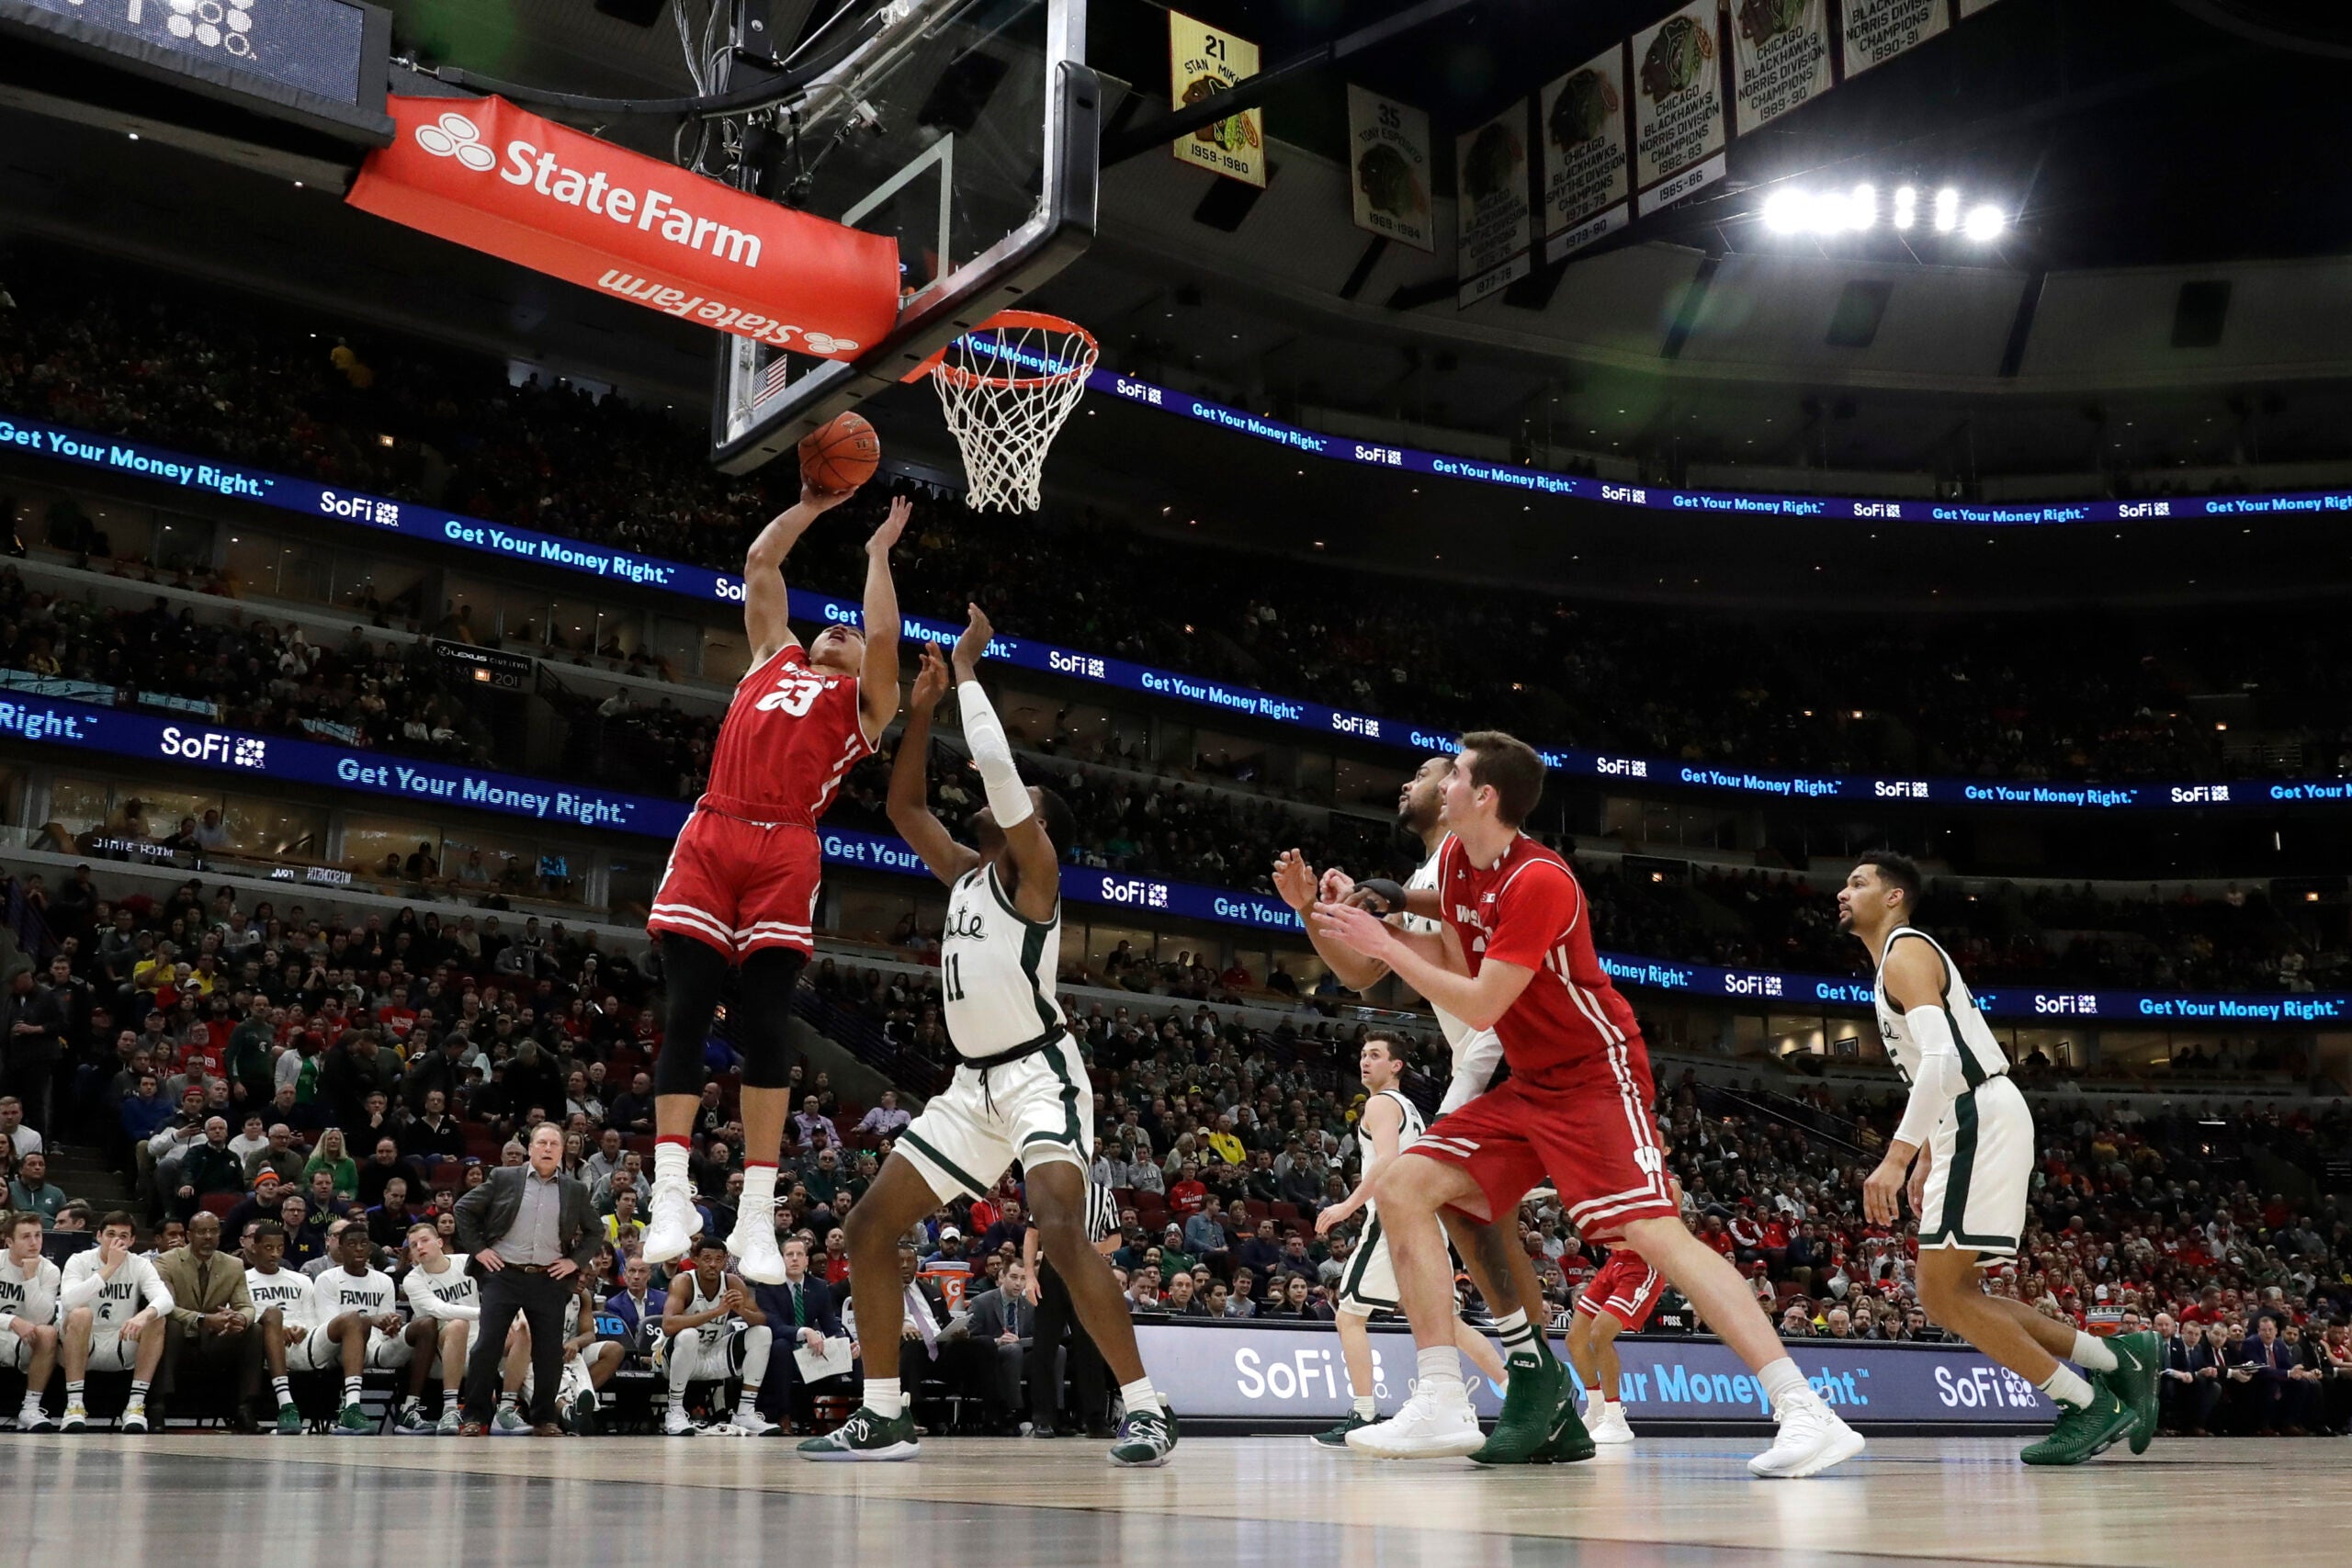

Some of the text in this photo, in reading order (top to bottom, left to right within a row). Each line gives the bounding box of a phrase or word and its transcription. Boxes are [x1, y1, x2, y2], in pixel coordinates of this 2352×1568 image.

[1846, 14, 1889, 42] NORRIS
[1860, 8, 1928, 52] CHAMPIONS
[1205, 35, 1226, 62] 21
[1744, 32, 1818, 82] BLACKHAWKS
[1757, 26, 1804, 61] CHICAGO
[1871, 29, 1919, 62] 1990-91
[1184, 59, 1241, 83] STAN MIK
[1738, 44, 1825, 101] NORRIS DIVISION
[1656, 85, 1700, 117] CHICAGO
[1751, 67, 1814, 109] CHAMPIONS
[1378, 104, 1400, 129] 35
[1645, 91, 1713, 137] BLACKHAWKS
[1760, 86, 1806, 121] 1989-90
[1639, 103, 1720, 154] NORRIS DIVISION
[1191, 143, 1249, 174] 1959-1980
[1565, 136, 1605, 165] CHICAGO
[1651, 124, 1709, 164] CHAMPIONS
[1553, 143, 1617, 186] BLACKHAWKS
[1658, 143, 1702, 175] 1982-83
[1546, 152, 1626, 204] SMYTHE DIVISION
[1659, 170, 1702, 201] 1985-86
[1558, 175, 1613, 211] CHAMPIONS
[1116, 378, 1147, 400] SoFi
[1192, 402, 1216, 421] Get
[1216, 409, 1247, 429] Your
[1248, 418, 1288, 442] Money
[0, 421, 42, 448] Get
[47, 431, 106, 462] Your
[109, 446, 194, 485] Money
[1354, 445, 1386, 464] SoFi
[1432, 458, 1458, 475] Get
[1459, 462, 1490, 479] Your
[1491, 468, 1535, 490] Money
[320, 491, 373, 521] SoFi
[1601, 485, 1631, 502] SoFi
[1672, 495, 1699, 508] Get
[1700, 496, 1733, 510] Your
[1734, 498, 1781, 514] Money
[2205, 501, 2234, 513] Get
[2234, 500, 2270, 513] Your
[2271, 498, 2322, 512] Money
[1853, 502, 1885, 517] SoFi
[1932, 507, 1958, 521] Get
[1959, 509, 1991, 522] Your
[1992, 510, 2041, 524] Money
[2119, 502, 2153, 518] SoFi
[444, 520, 485, 545] Get
[488, 528, 537, 556] Your
[540, 540, 609, 575] Money
[824, 603, 858, 626] Get
[1049, 650, 1086, 675] SoFi
[754, 678, 824, 717] 23
[1141, 671, 1170, 693] Get
[1171, 678, 1206, 700] Your
[1208, 686, 1257, 715] Money
[1332, 712, 1363, 735] SoFi
[160, 727, 231, 763] SoFi
[1410, 731, 1435, 750] Get
[1597, 758, 1630, 776] SoFi
[1680, 767, 1707, 784] Get
[1709, 770, 1741, 787] Your
[1743, 774, 1792, 796] Money
[337, 758, 389, 786] Get
[395, 766, 457, 796] Your
[462, 777, 550, 817] Money
[1874, 781, 1910, 797] SoFi
[1964, 785, 1994, 800] Get
[1995, 786, 2031, 802] Your
[2033, 787, 2085, 807] Money
[2171, 785, 2210, 803] SoFi
[2270, 785, 2301, 800] Get
[2303, 784, 2343, 798] Your
[824, 836, 920, 868] Get Your
[1101, 876, 1146, 905] SoFi
[1214, 897, 1248, 919] Get
[1250, 899, 1293, 926] Your
[945, 953, 965, 1002] 11
[1724, 973, 1763, 995] SoFi
[1815, 983, 1847, 1000] Get
[2034, 994, 2075, 1014] SoFi
[2139, 998, 2173, 1015] Get
[2175, 999, 2216, 1016] Your
[2219, 1000, 2280, 1021] Money
[253, 1286, 302, 1301] FAMILY
[340, 1290, 384, 1307] FAMILY
[946, 1280, 961, 1296] G
[1663, 1315, 1683, 1327] POSS.
[1235, 1348, 1337, 1399] SoFi
[1934, 1366, 2005, 1409] SoFi
